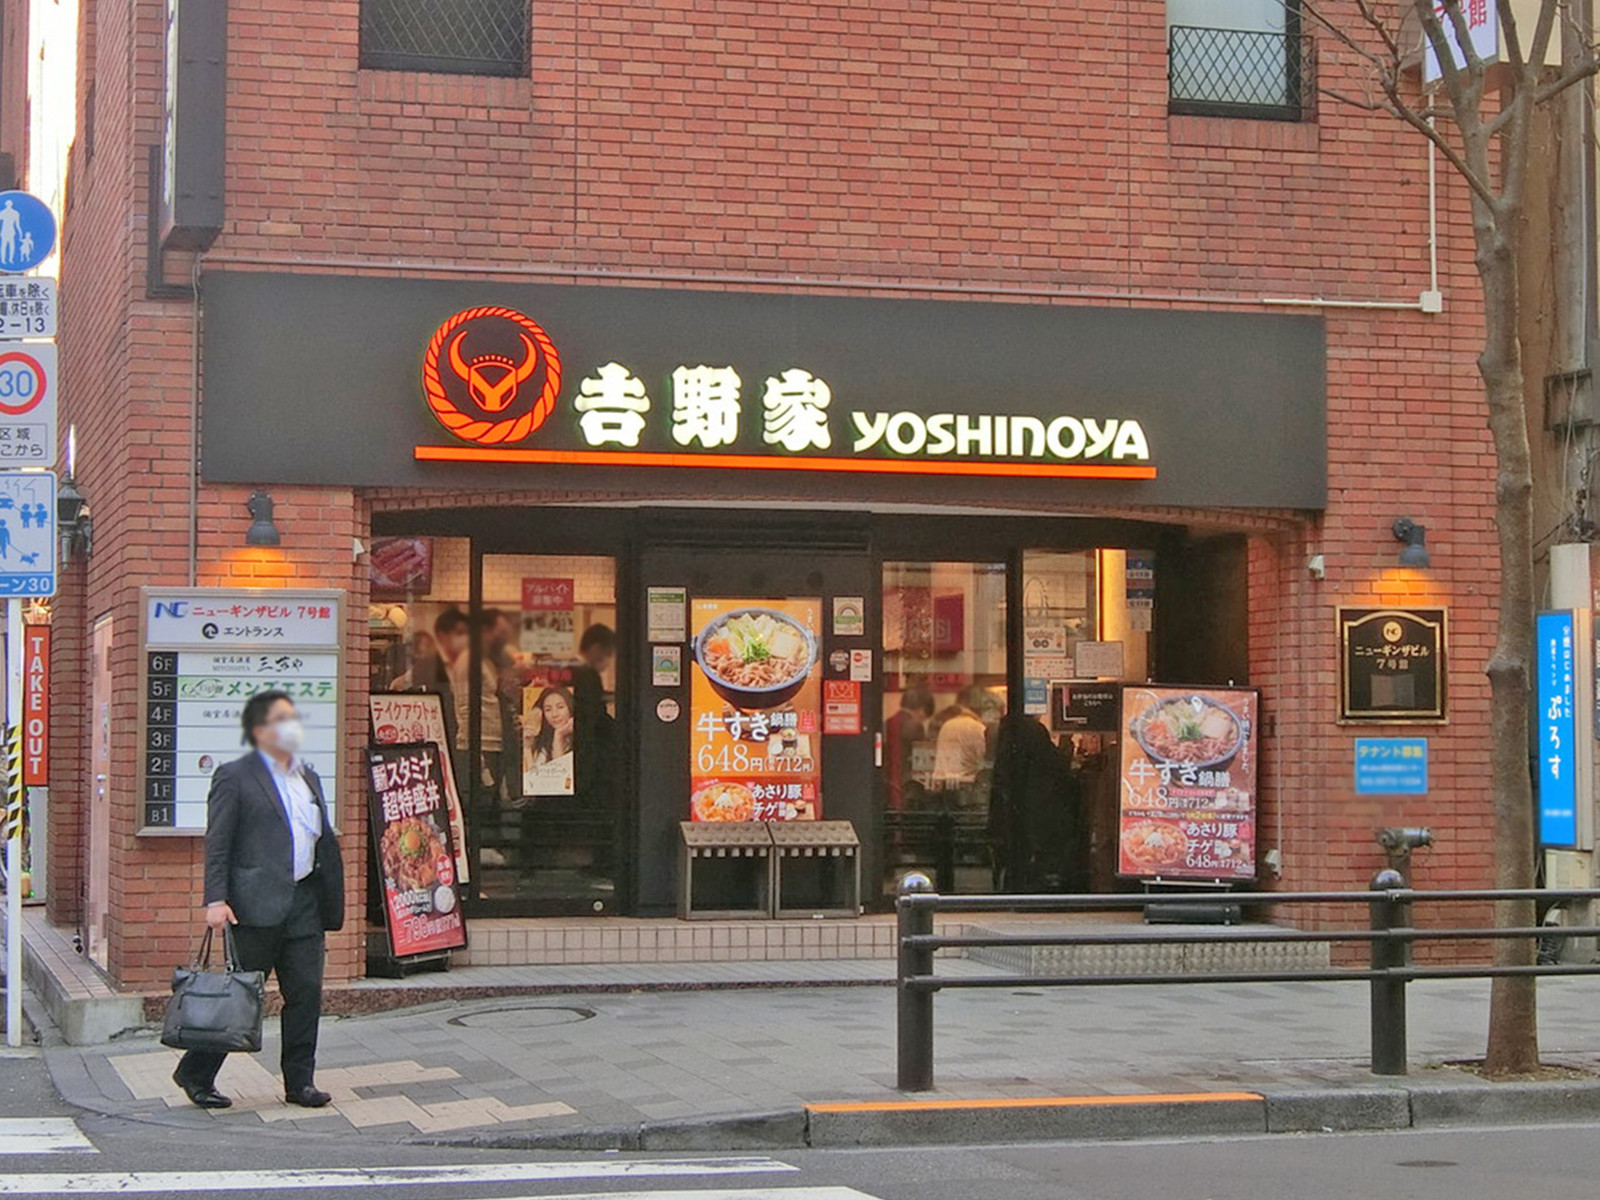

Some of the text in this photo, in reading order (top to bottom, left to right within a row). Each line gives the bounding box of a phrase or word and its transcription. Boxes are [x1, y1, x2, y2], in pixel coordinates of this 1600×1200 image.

[0, 370, 32, 397] 30
[573, 361, 832, 451] 吉野家
[0, 427, 30, 440] 区域
[851, 410, 1150, 462] YOSHINOYA
[192, 605, 292, 618] ニューギンザビル
[297, 605, 331, 619] 7号館
[223, 626, 284, 637] エントランス
[1355, 645, 1430, 657] ニューギンザビル
[152, 657, 172, 671] 6F
[151, 681, 171, 695] 5F
[28, 636, 44, 775] TAKE OUT
[151, 706, 171, 720] 4F
[151, 732, 171, 745] 3F
[151, 758, 171, 771] 2F
[387, 751, 434, 787] スタミナ
[152, 783, 170, 797] 1F
[382, 780, 441, 824] 超特盛丼
[151, 808, 169, 822] B1
[1186, 821, 1238, 839] あさり豚
